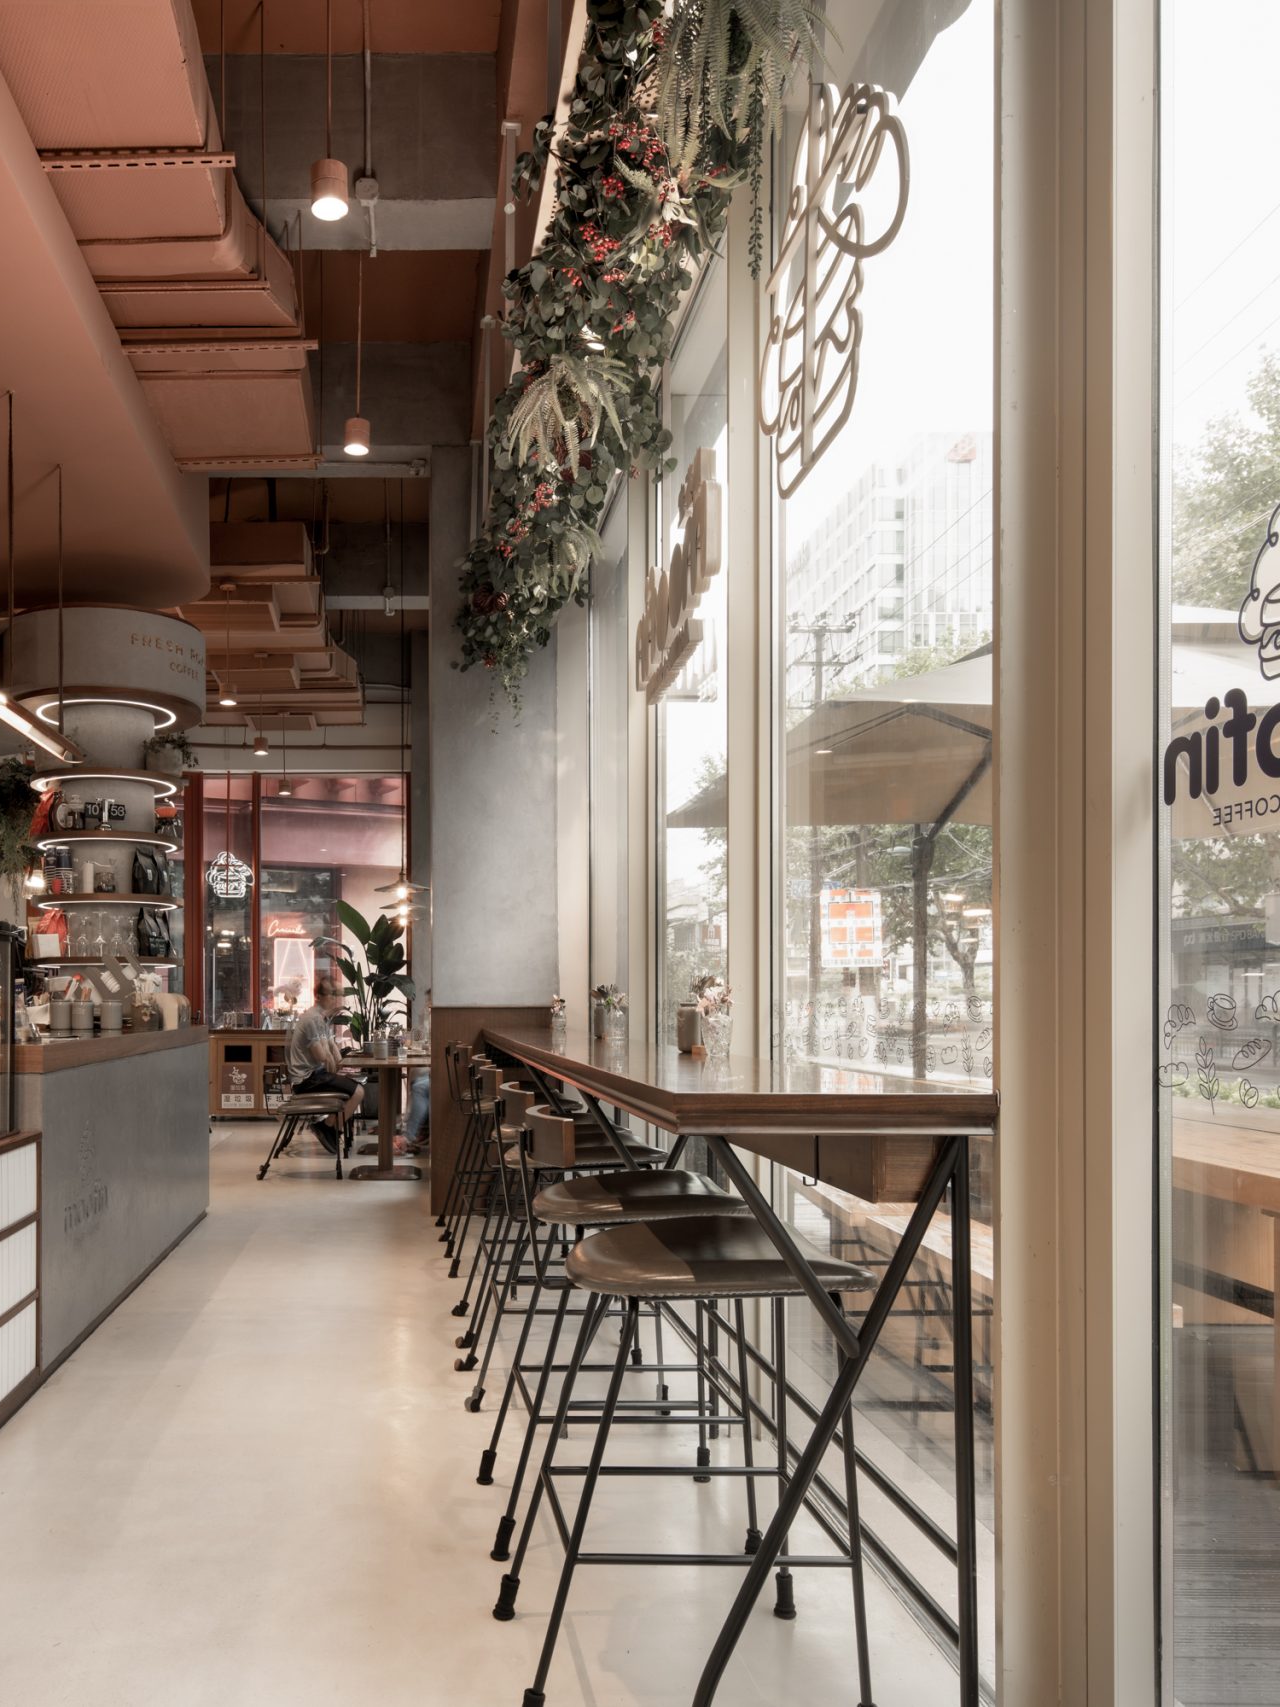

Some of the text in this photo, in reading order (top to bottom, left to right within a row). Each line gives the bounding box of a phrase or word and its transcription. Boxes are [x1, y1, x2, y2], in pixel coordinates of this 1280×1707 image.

[130, 633, 184, 656] FRESH
[169, 662, 199, 680] COFFEE
[87, 804, 100, 815] 10
